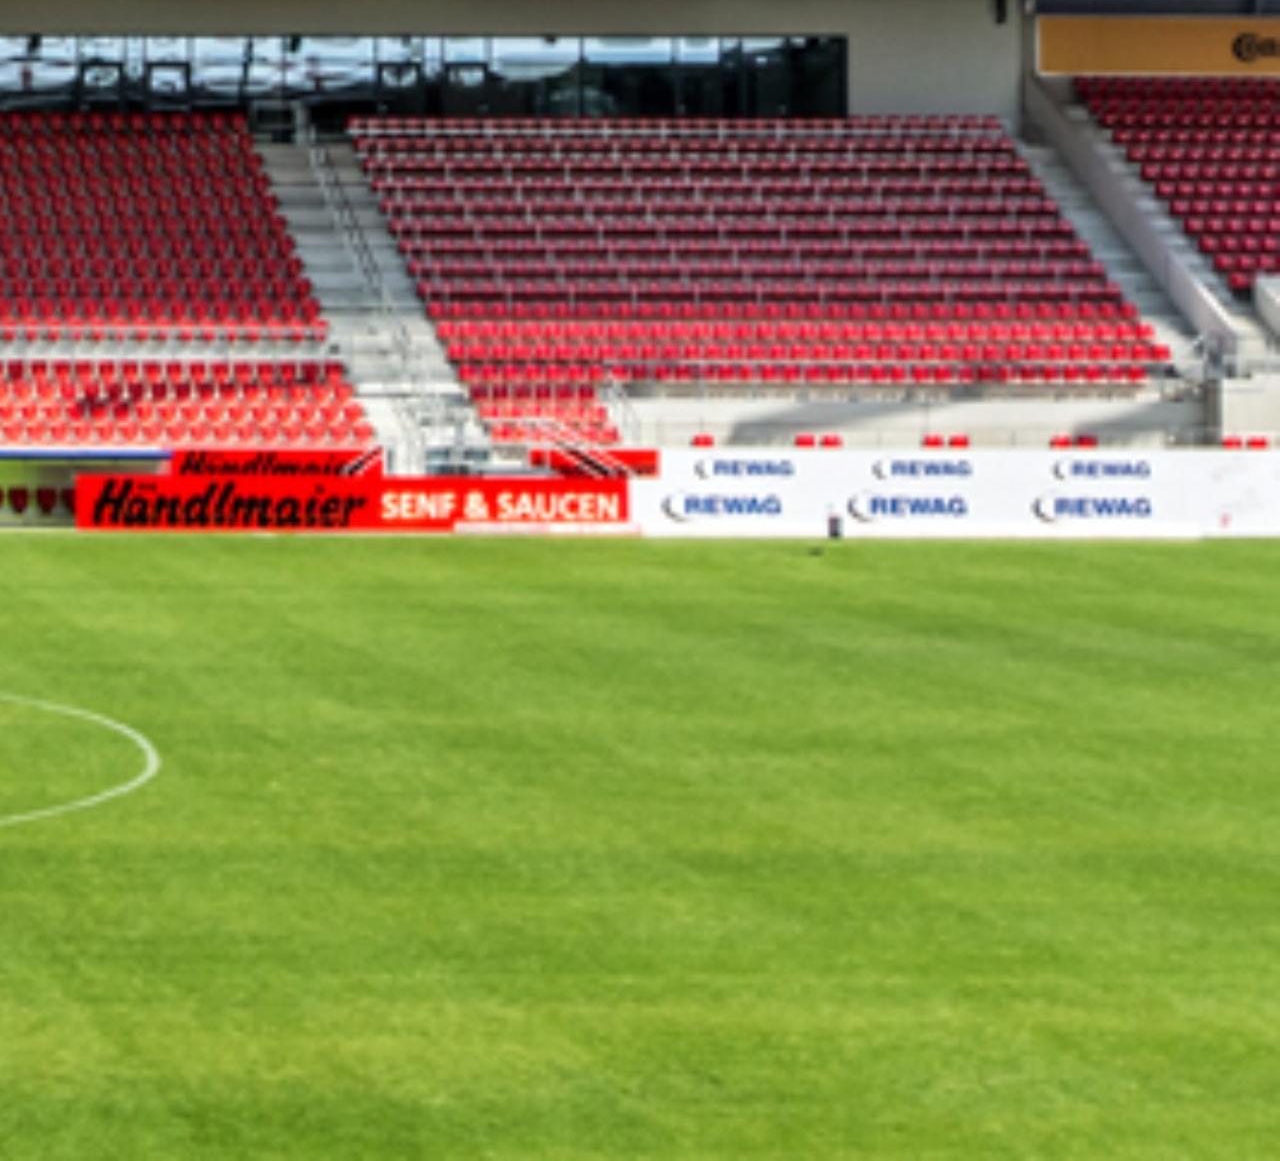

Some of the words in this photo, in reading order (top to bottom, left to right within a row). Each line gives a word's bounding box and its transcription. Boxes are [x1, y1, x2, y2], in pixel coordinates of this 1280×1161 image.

[713, 460, 794, 476] REWAG
[891, 460, 973, 476] REWAG
[1070, 461, 1151, 477] REWAG
[93, 479, 366, 527] Händlmaier
[381, 491, 456, 519] SENF
[463, 491, 489, 519] &
[497, 491, 619, 520] SAUCEN
[684, 496, 782, 515] REWAG
[870, 496, 967, 515] REWAG
[1054, 498, 1152, 517] REWAG
